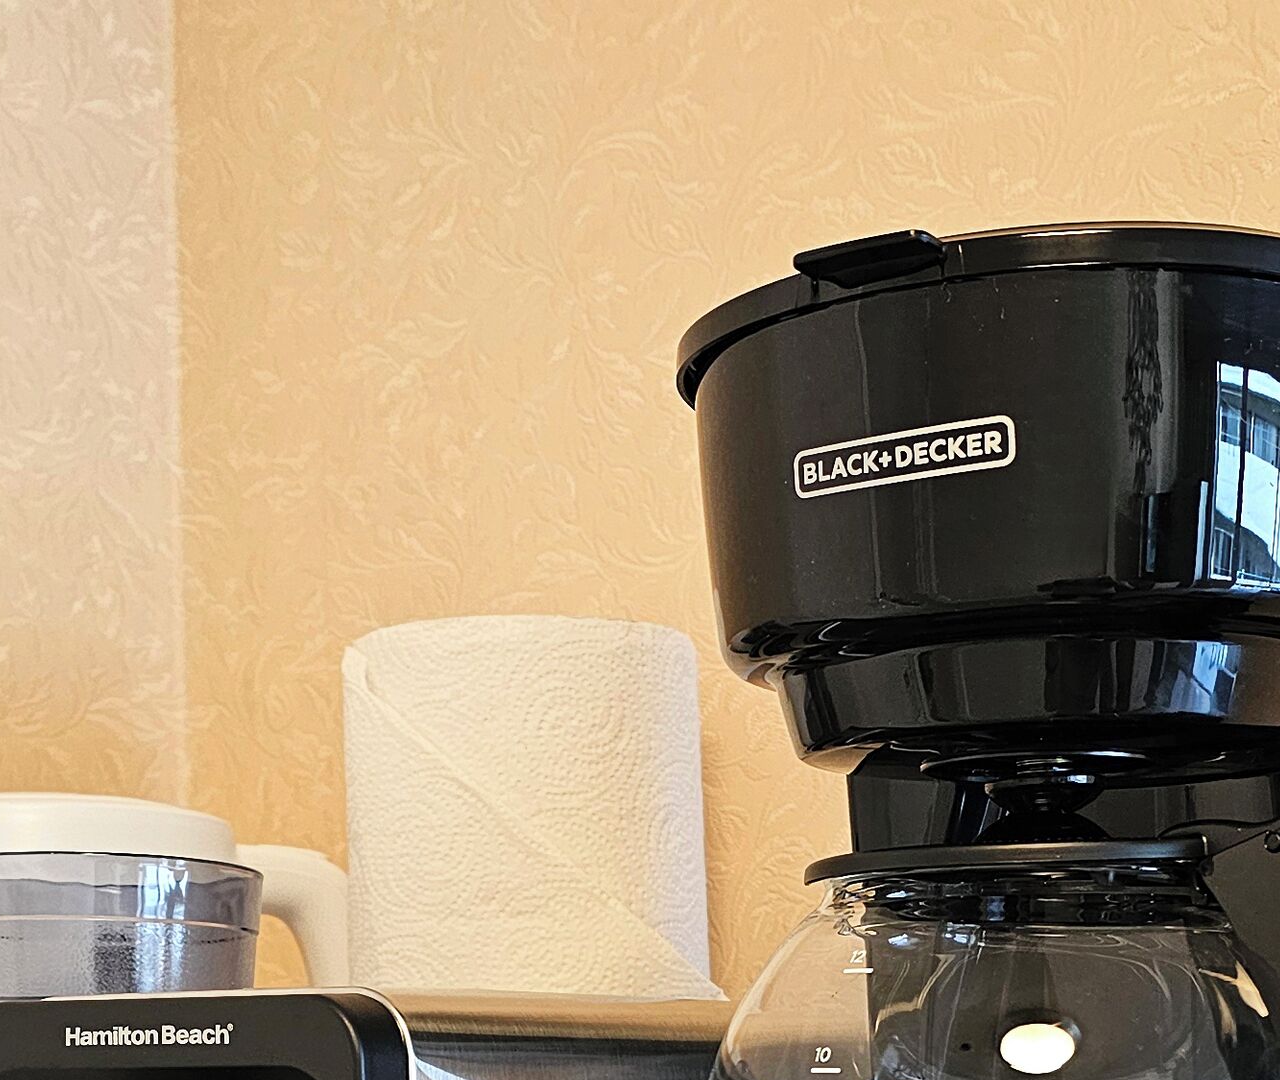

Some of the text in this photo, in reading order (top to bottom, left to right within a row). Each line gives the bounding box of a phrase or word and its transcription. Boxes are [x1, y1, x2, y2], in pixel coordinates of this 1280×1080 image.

[802, 429, 1003, 486] BLACK+DECKER
[849, 950, 867, 964] 12
[64, 1025, 159, 1047] Hamilton
[814, 1046, 832, 1063] 10
